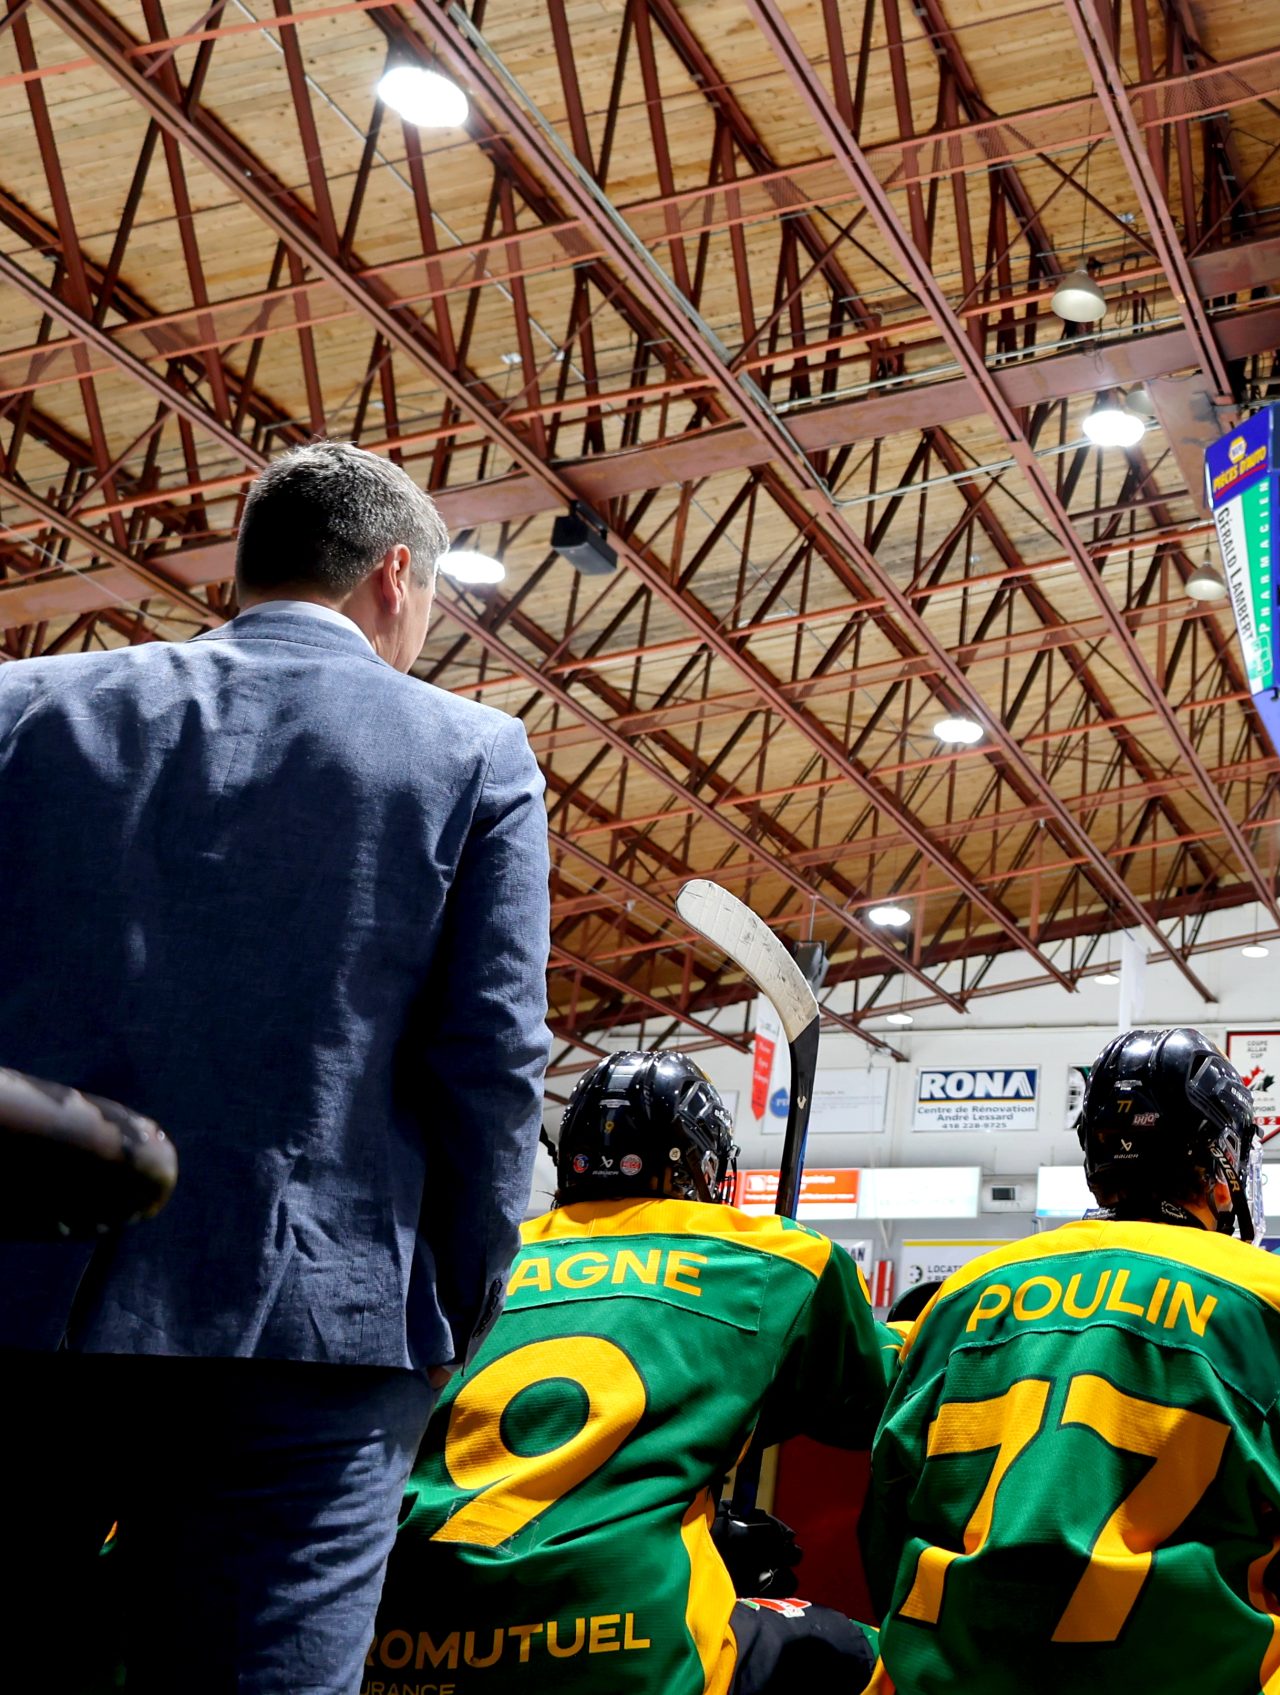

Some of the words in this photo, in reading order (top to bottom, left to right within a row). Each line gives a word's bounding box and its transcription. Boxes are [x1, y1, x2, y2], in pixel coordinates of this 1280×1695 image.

[1217, 506, 1236, 567] GÉRALD
[1231, 566, 1255, 642] LAMBERT
[920, 1071, 1035, 1099] RONA
[917, 1105, 953, 1115] Centre
[955, 1105, 970, 1113] de
[971, 1104, 1035, 1113] Rénovation
[936, 1113, 970, 1122] André
[972, 1113, 1014, 1122] Lessard
[1117, 1100, 1133, 1113] 77
[604, 1120, 615, 1134] 9
[506, 1248, 708, 1297] AGNE
[927, 1265, 962, 1273] LOCAT
[964, 1269, 1218, 1337] POULIN
[428, 1333, 648, 1549] 9
[898, 1372, 1232, 1643] 77
[365, 1611, 651, 1671] OMUTUEL
